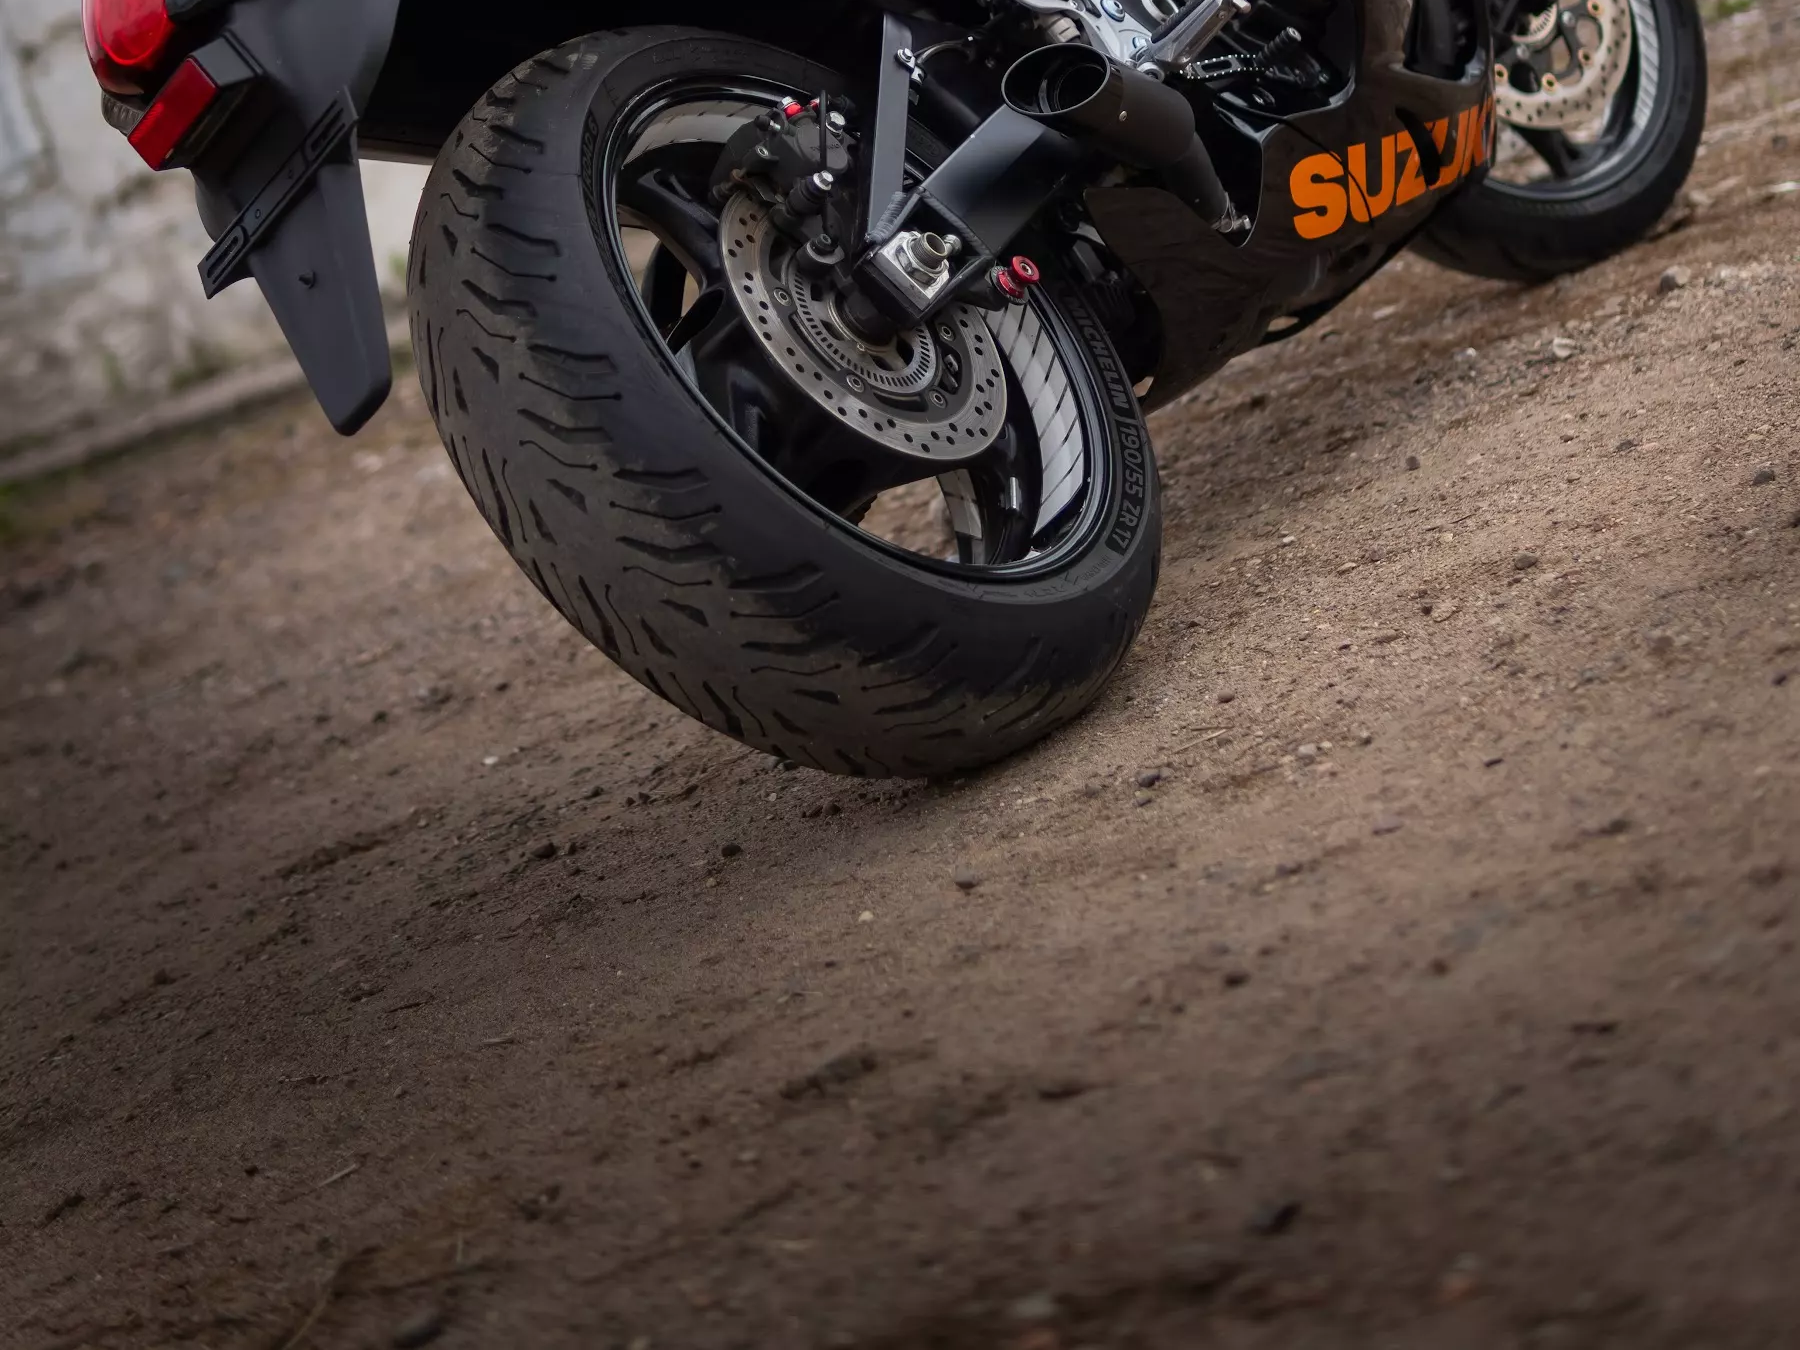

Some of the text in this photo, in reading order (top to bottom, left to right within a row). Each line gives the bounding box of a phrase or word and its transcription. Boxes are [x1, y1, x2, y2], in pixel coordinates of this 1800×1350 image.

[1290, 96, 1494, 239] SUZUK
[1063, 296, 1129, 409] MICHELIN
[1111, 426, 1143, 549] 190/55 ZR 17
